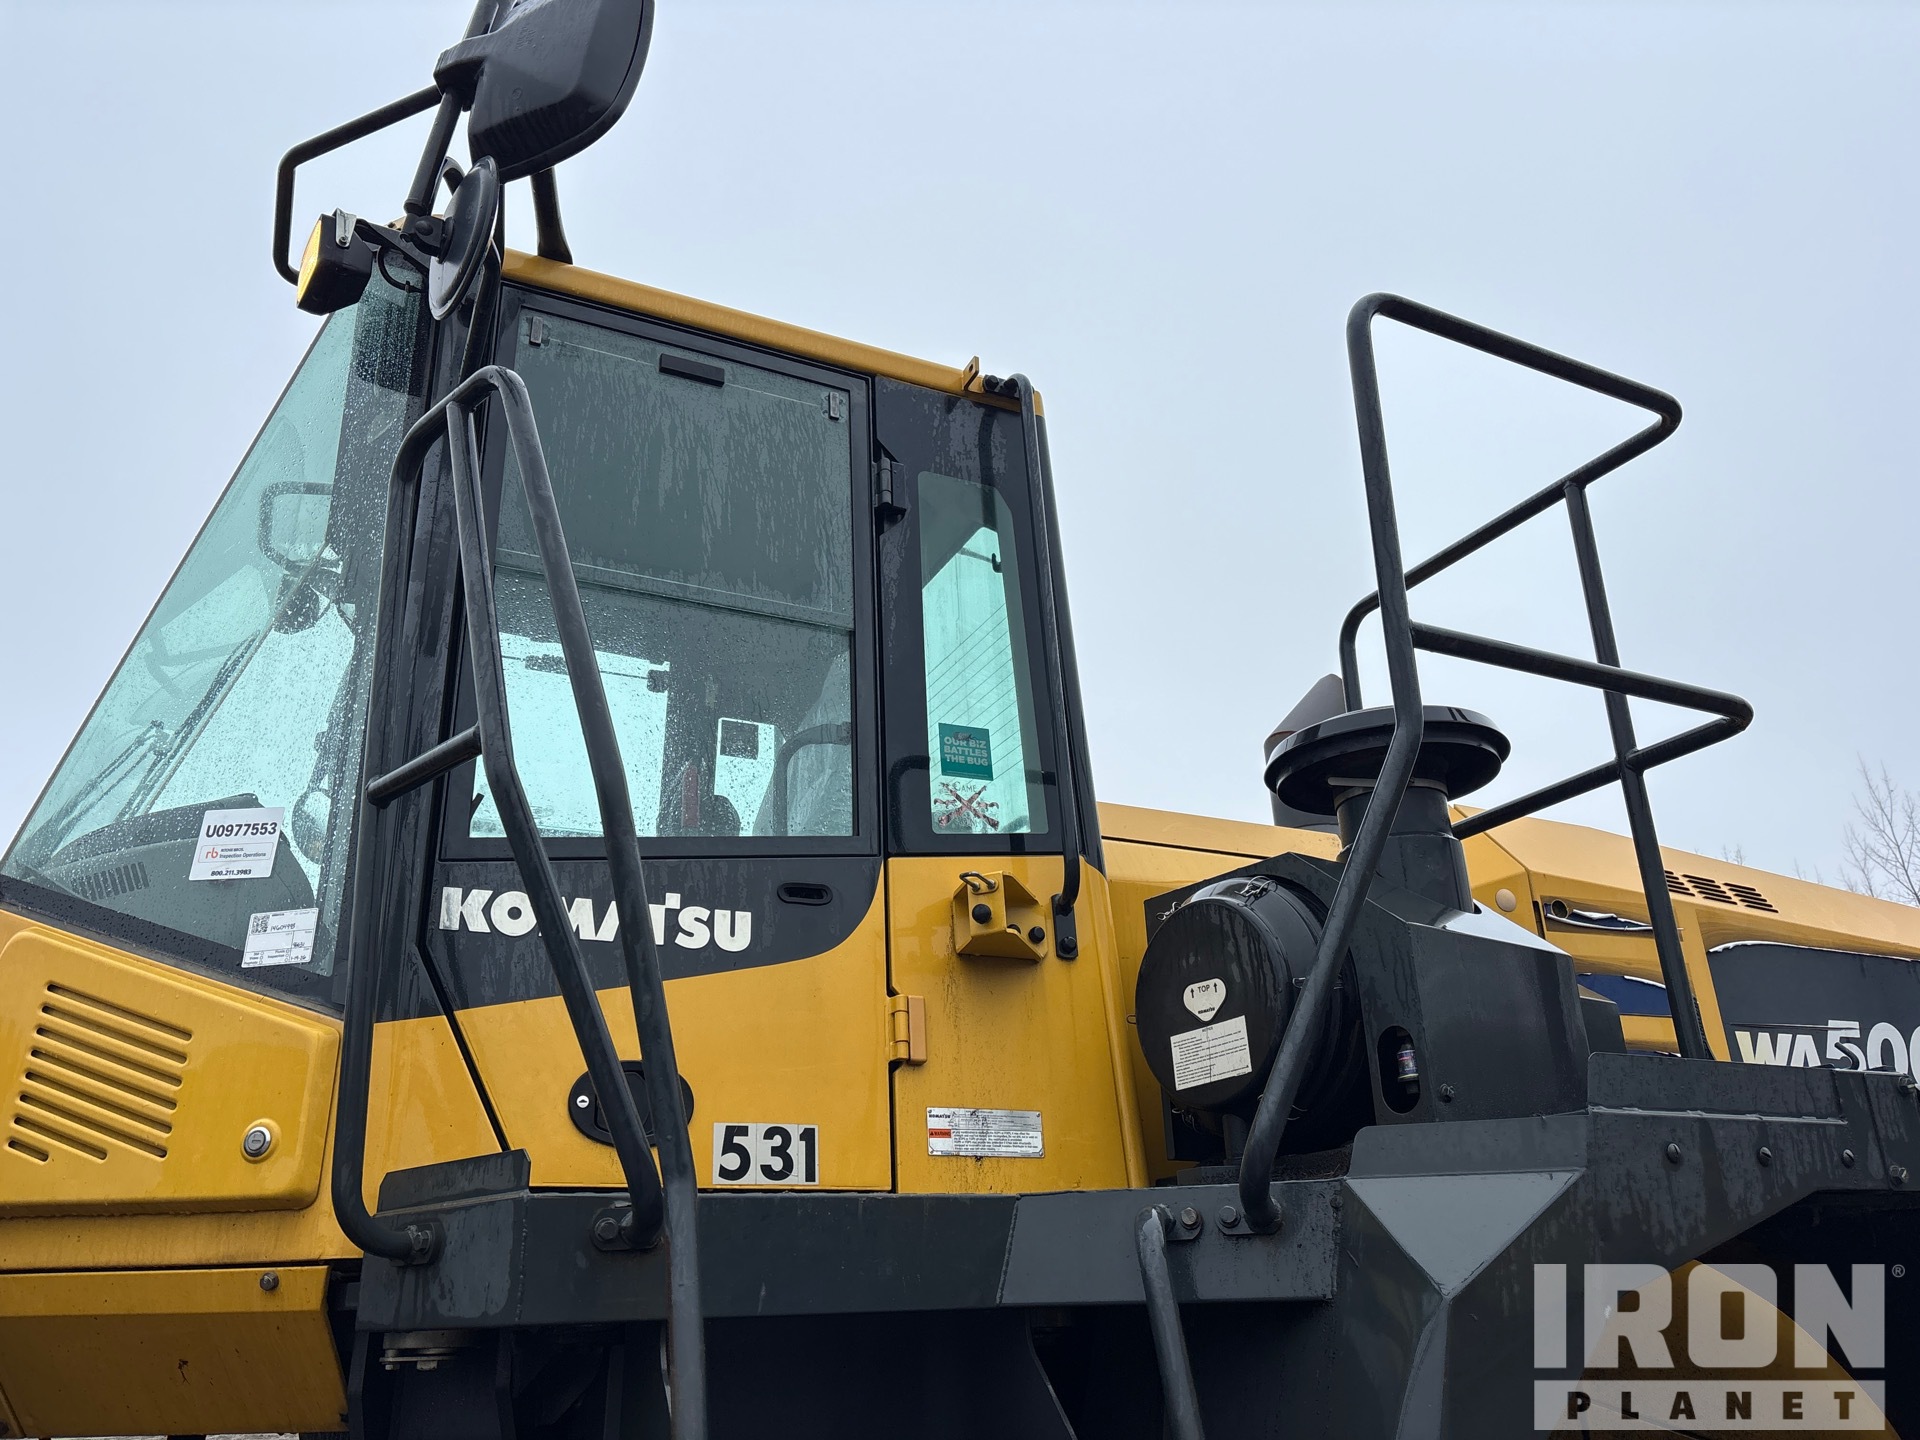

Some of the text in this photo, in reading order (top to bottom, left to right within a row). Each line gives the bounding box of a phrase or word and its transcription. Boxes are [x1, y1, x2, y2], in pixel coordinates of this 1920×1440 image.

[944, 736, 968, 747] OUR
[944, 745, 988, 758] BATTLES
[944, 754, 989, 767] THE BUG
[205, 822, 278, 838] U0977553
[205, 847, 219, 859] rb
[1197, 984, 1211, 993] TOP
[1735, 1019, 1920, 1092] WA50
[718, 1125, 816, 1183] 531
